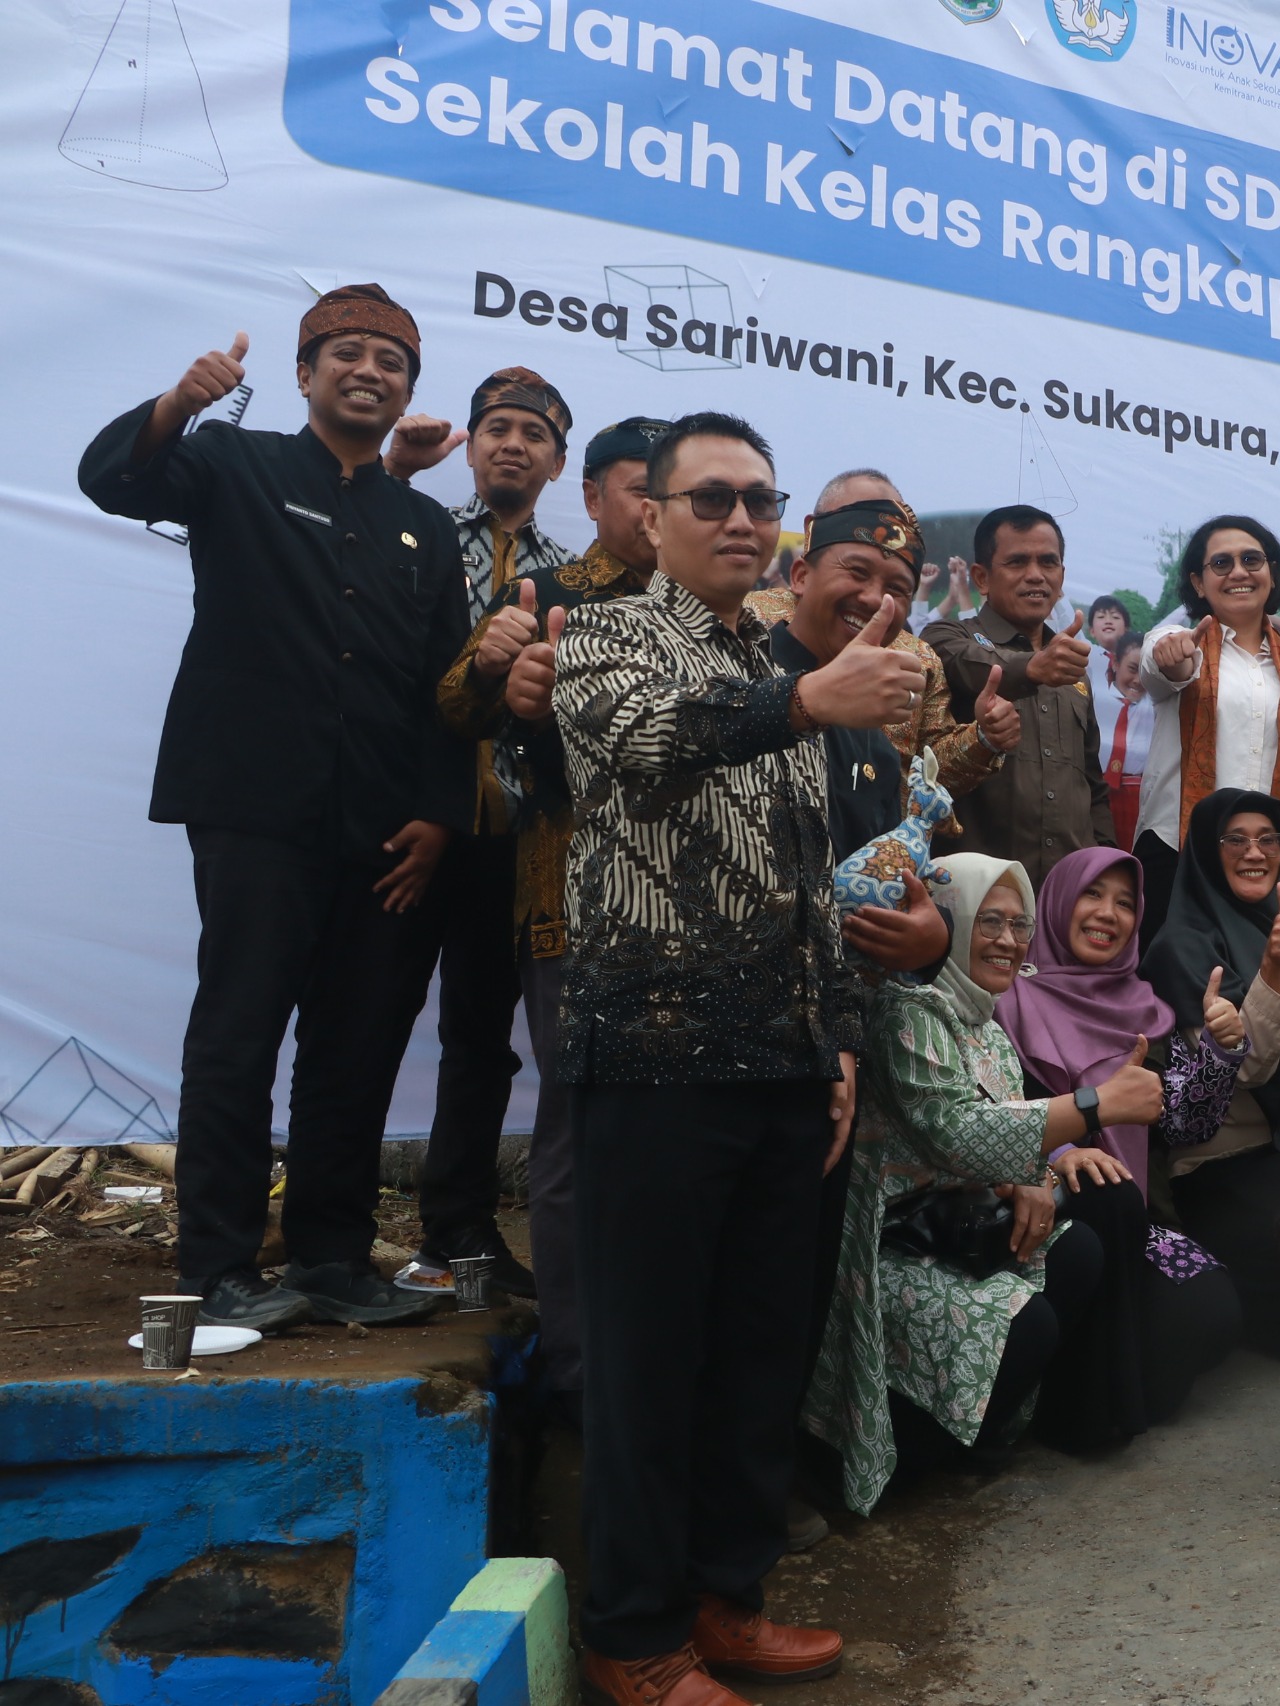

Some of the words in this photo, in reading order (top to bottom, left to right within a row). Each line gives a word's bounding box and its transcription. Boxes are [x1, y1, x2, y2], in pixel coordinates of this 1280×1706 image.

[835, 61, 1107, 205] Datang
[1126, 146, 1187, 209] di
[1165, 52, 1197, 71] Inovasi
[1199, 65, 1225, 79] untuk
[1228, 72, 1250, 87] Anak
[1214, 82, 1255, 102] Kemitraan
[365, 57, 739, 195] Sekolah
[766, 143, 981, 247] Kelas
[474, 271, 628, 341] Desa
[646, 304, 908, 397] Sariwani,
[924, 355, 1030, 413] Kec.
[1043, 380, 1279, 466] Sukapura,
